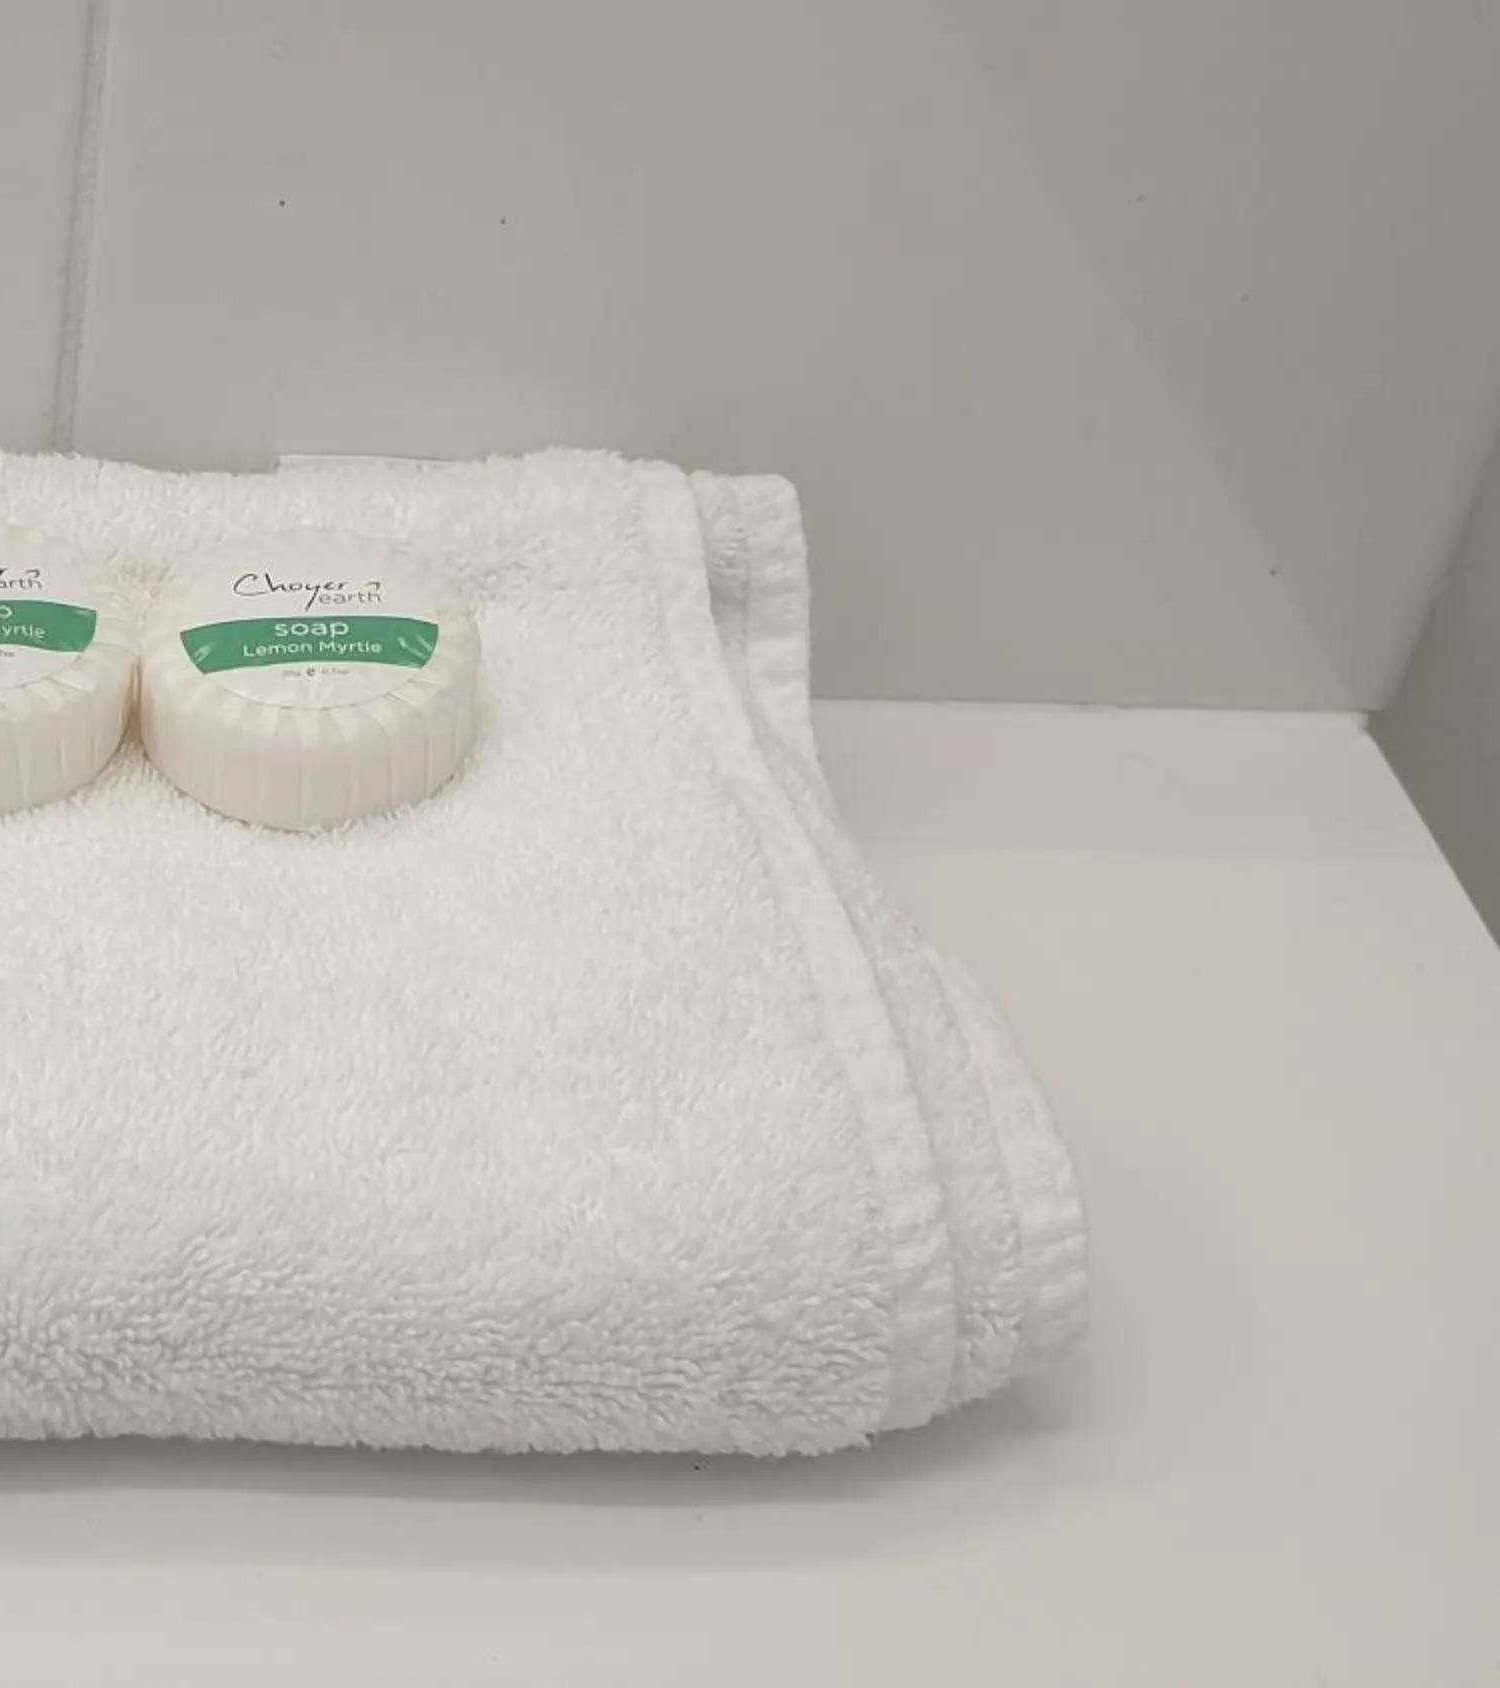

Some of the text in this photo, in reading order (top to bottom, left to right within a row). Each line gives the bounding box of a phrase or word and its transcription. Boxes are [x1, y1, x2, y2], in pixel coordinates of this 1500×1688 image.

[318, 588, 382, 604] earth
[275, 620, 349, 638] soap
[242, 640, 383, 658] Lemon Myrtle
